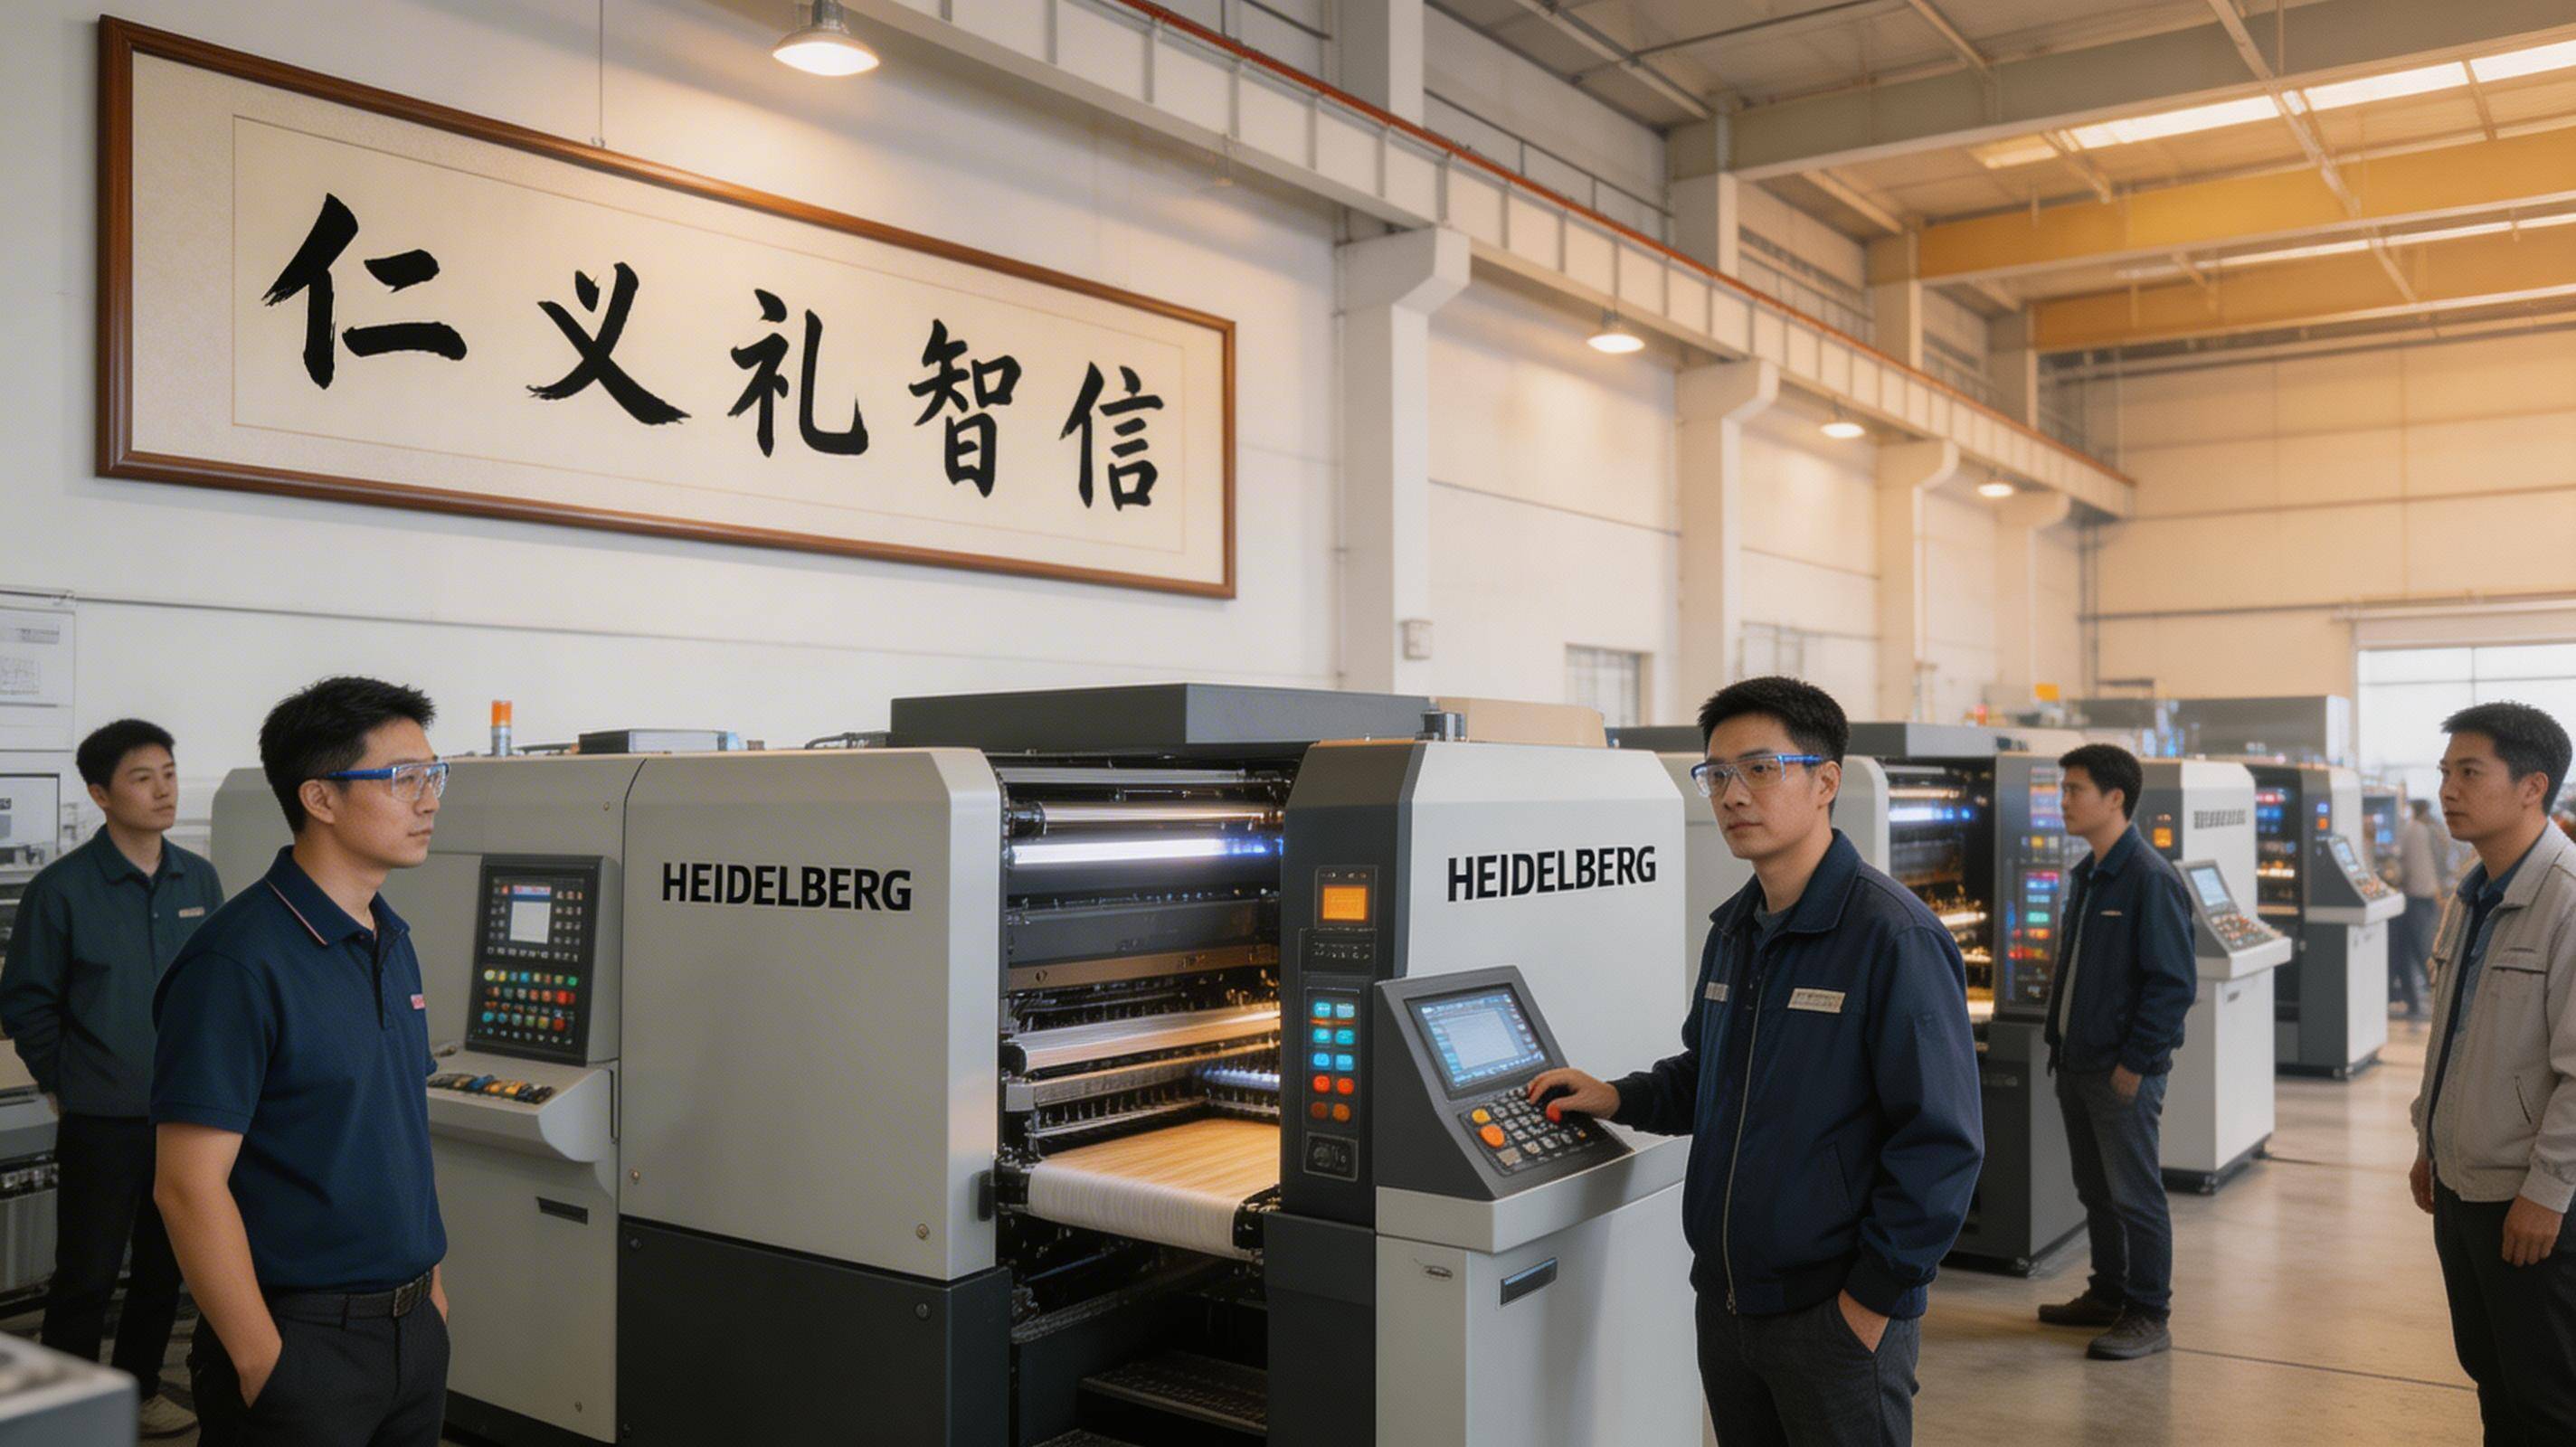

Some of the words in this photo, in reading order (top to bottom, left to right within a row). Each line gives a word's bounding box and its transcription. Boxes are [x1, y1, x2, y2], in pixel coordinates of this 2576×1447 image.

[263, 193, 1165, 511] 仁义礼智信
[661, 862, 913, 912] HEIDELBERG
[1448, 846, 1656, 903] HEIDELBERG
